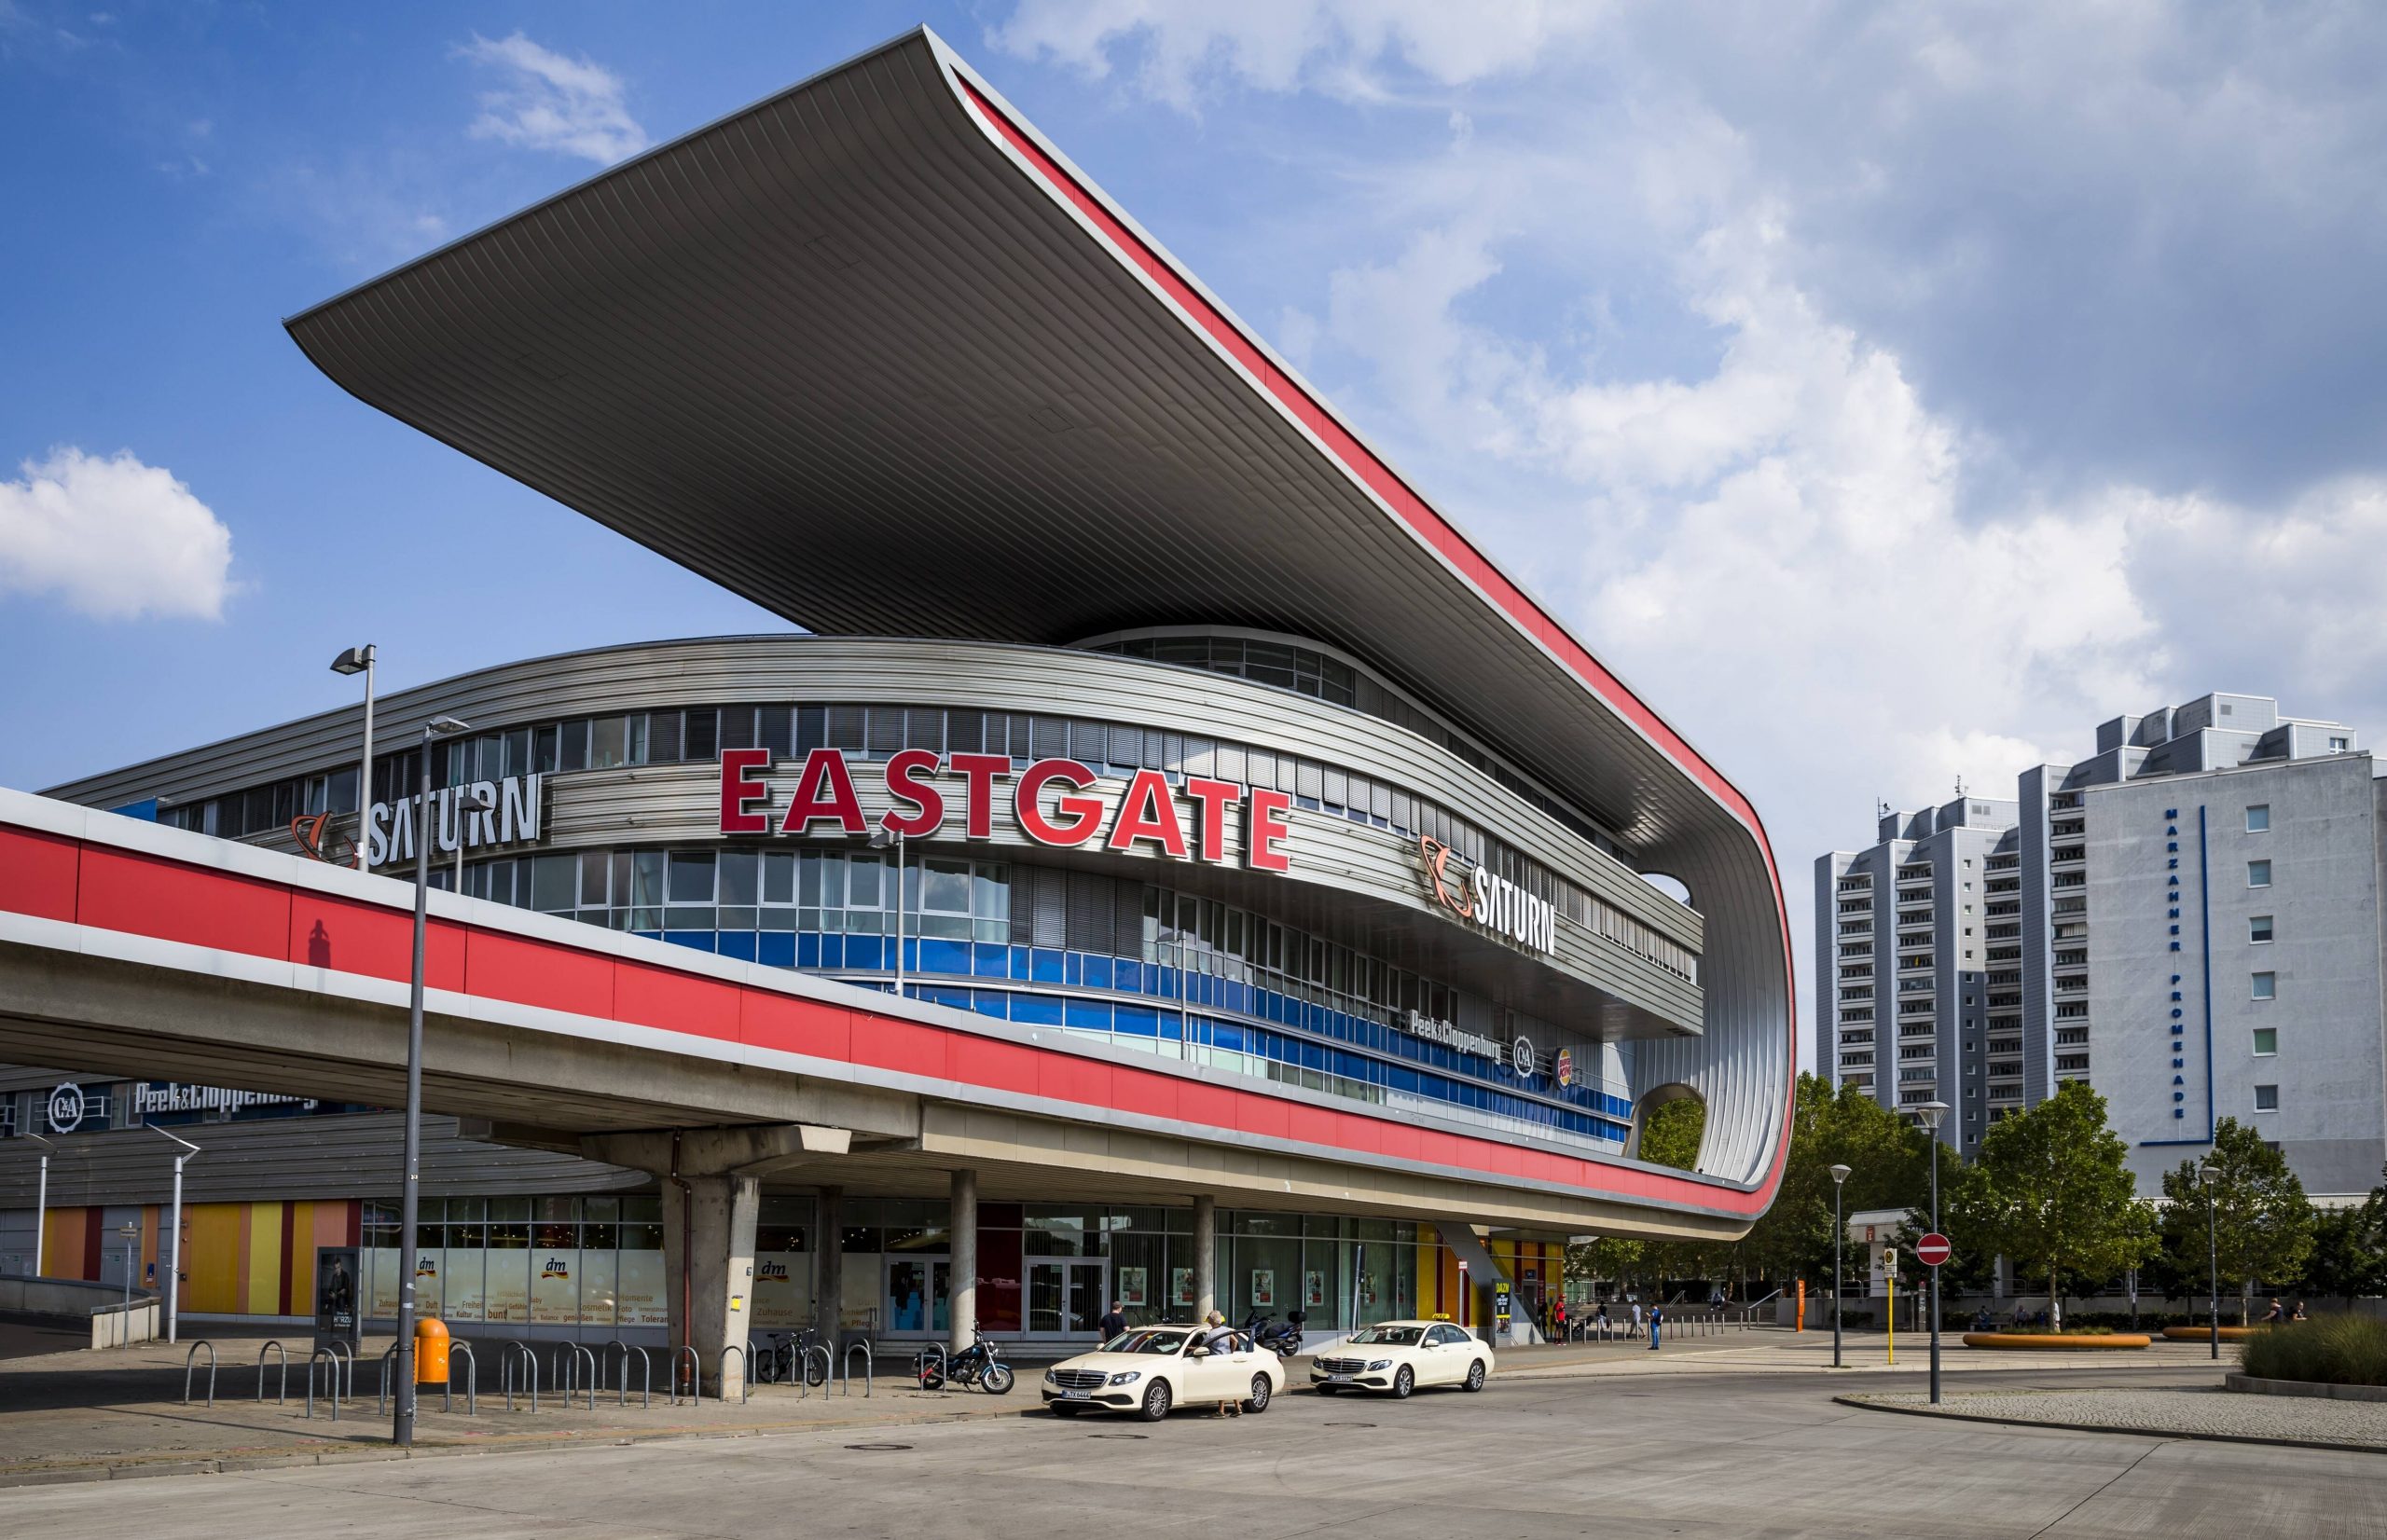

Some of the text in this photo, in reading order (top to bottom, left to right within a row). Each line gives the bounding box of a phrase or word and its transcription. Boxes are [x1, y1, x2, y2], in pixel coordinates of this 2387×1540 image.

[720, 748, 1291, 873] EASTGATE
[1474, 865, 1555, 956] SATURN
[2165, 808, 2184, 1119] MARZAHNER PROMENADE
[1410, 1009, 1501, 1066] Peek&Cloppenburg
[1517, 1046, 1531, 1067] C&A
[1559, 1057, 1571, 1068] BURGER
[1559, 1065, 1572, 1079] KING
[54, 1095, 78, 1119] C&A
[419, 1257, 435, 1271] dm
[545, 1258, 566, 1272] dm
[761, 1260, 786, 1275] dm
[1496, 1282, 1510, 1294] DAZN
[457, 1310, 473, 1318] Kultur
[488, 1308, 508, 1320] bunt
[757, 1307, 793, 1317] Zuhause
